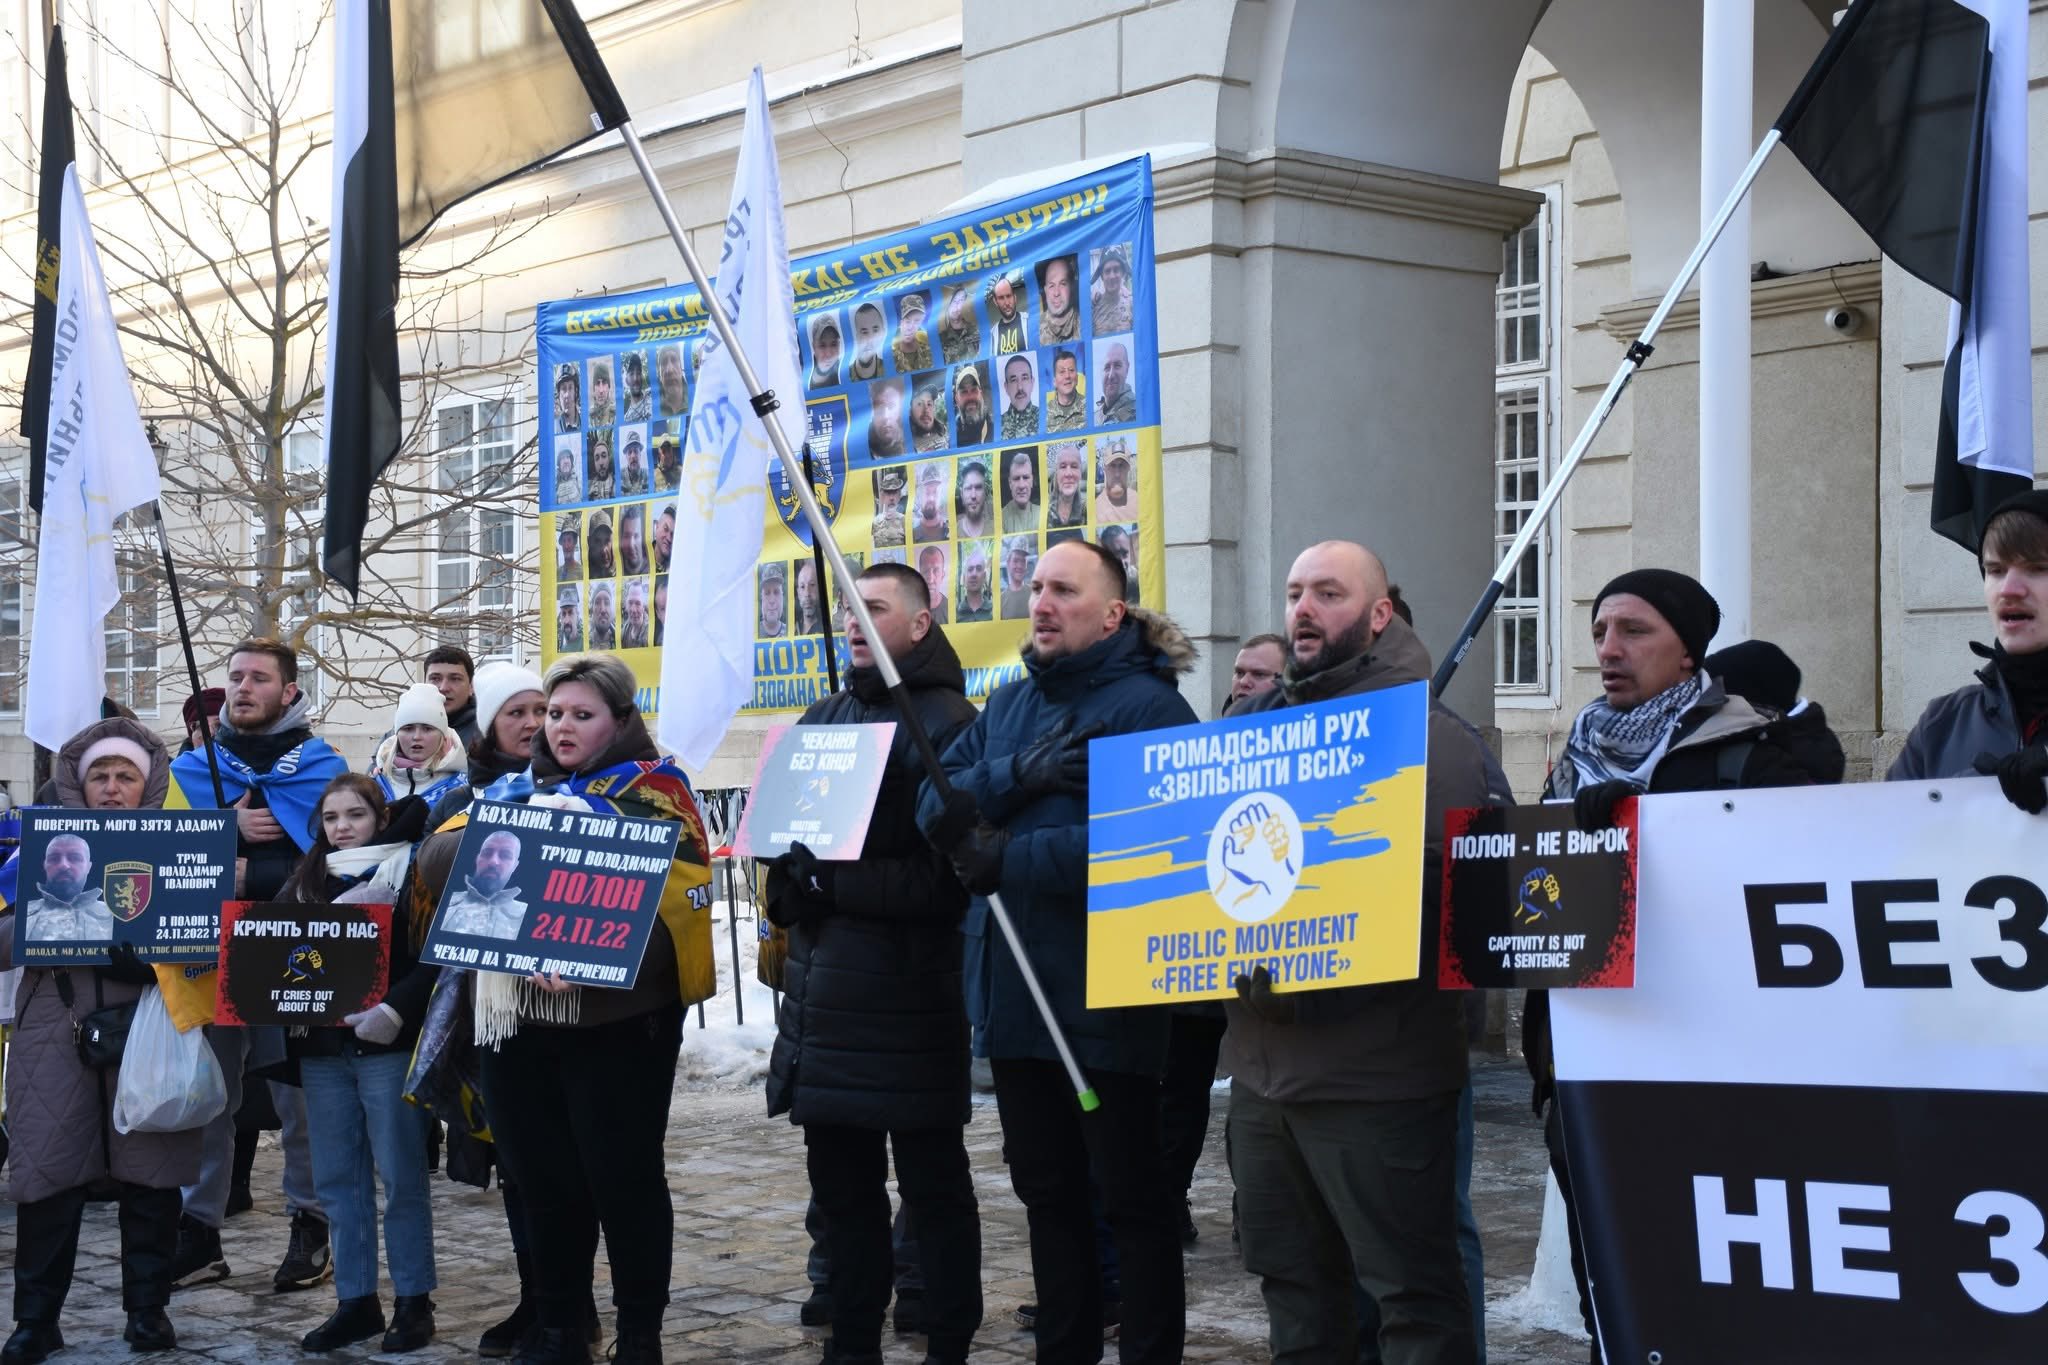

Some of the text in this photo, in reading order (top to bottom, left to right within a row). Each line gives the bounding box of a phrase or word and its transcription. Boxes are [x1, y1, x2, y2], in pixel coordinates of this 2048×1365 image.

[1143, 708, 1370, 774] ГРОМАДСЬКИЙ РУХ
[789, 752, 857, 773] БЕЗ КІНЦЯ
[1148, 745, 1365, 803] «ЗВІЛЬНИТИ ВСІХ»
[34, 818, 226, 833] ПОВЕРНІТЬ МОГО ЗЯТЯ ДОДОМУ
[477, 803, 672, 844] КОХАНИЙ, Я ТВІЙ ГОЛОС
[1451, 834, 1516, 859] ПОЛОН
[1536, 831, 1561, 856] НЕ
[1567, 827, 1629, 855] ВИРОК
[176, 853, 208, 865] ТРУШ
[541, 844, 670, 874] ТРУШ ВОЛОДИМИР
[159, 865, 224, 878] ВОЛОДИМИР
[164, 878, 217, 890] ІВАНОВИЧ
[543, 869, 646, 913] ПОЛОН
[159, 916, 167, 927] В
[234, 920, 378, 939] КРИЧІТЬ ПРО НАС
[530, 912, 632, 950] 24.11.22
[156, 928, 209, 940] 24.11.2022
[1147, 912, 1359, 963] PUBLIC MOVEMENT
[1488, 935, 1586, 952] CAPTIVITY IS NOT
[1743, 874, 2048, 993] БЕЗ
[433, 943, 479, 964] ЧЕКАЮ
[481, 952, 499, 968] НА
[1502, 953, 1570, 969] A SENTENCE
[1151, 962, 1218, 994] «FREE
[271, 990, 334, 1001] IT CRIES OUT
[277, 1001, 326, 1012] ABOUT US
[1692, 1174, 1901, 1301] НЕ
